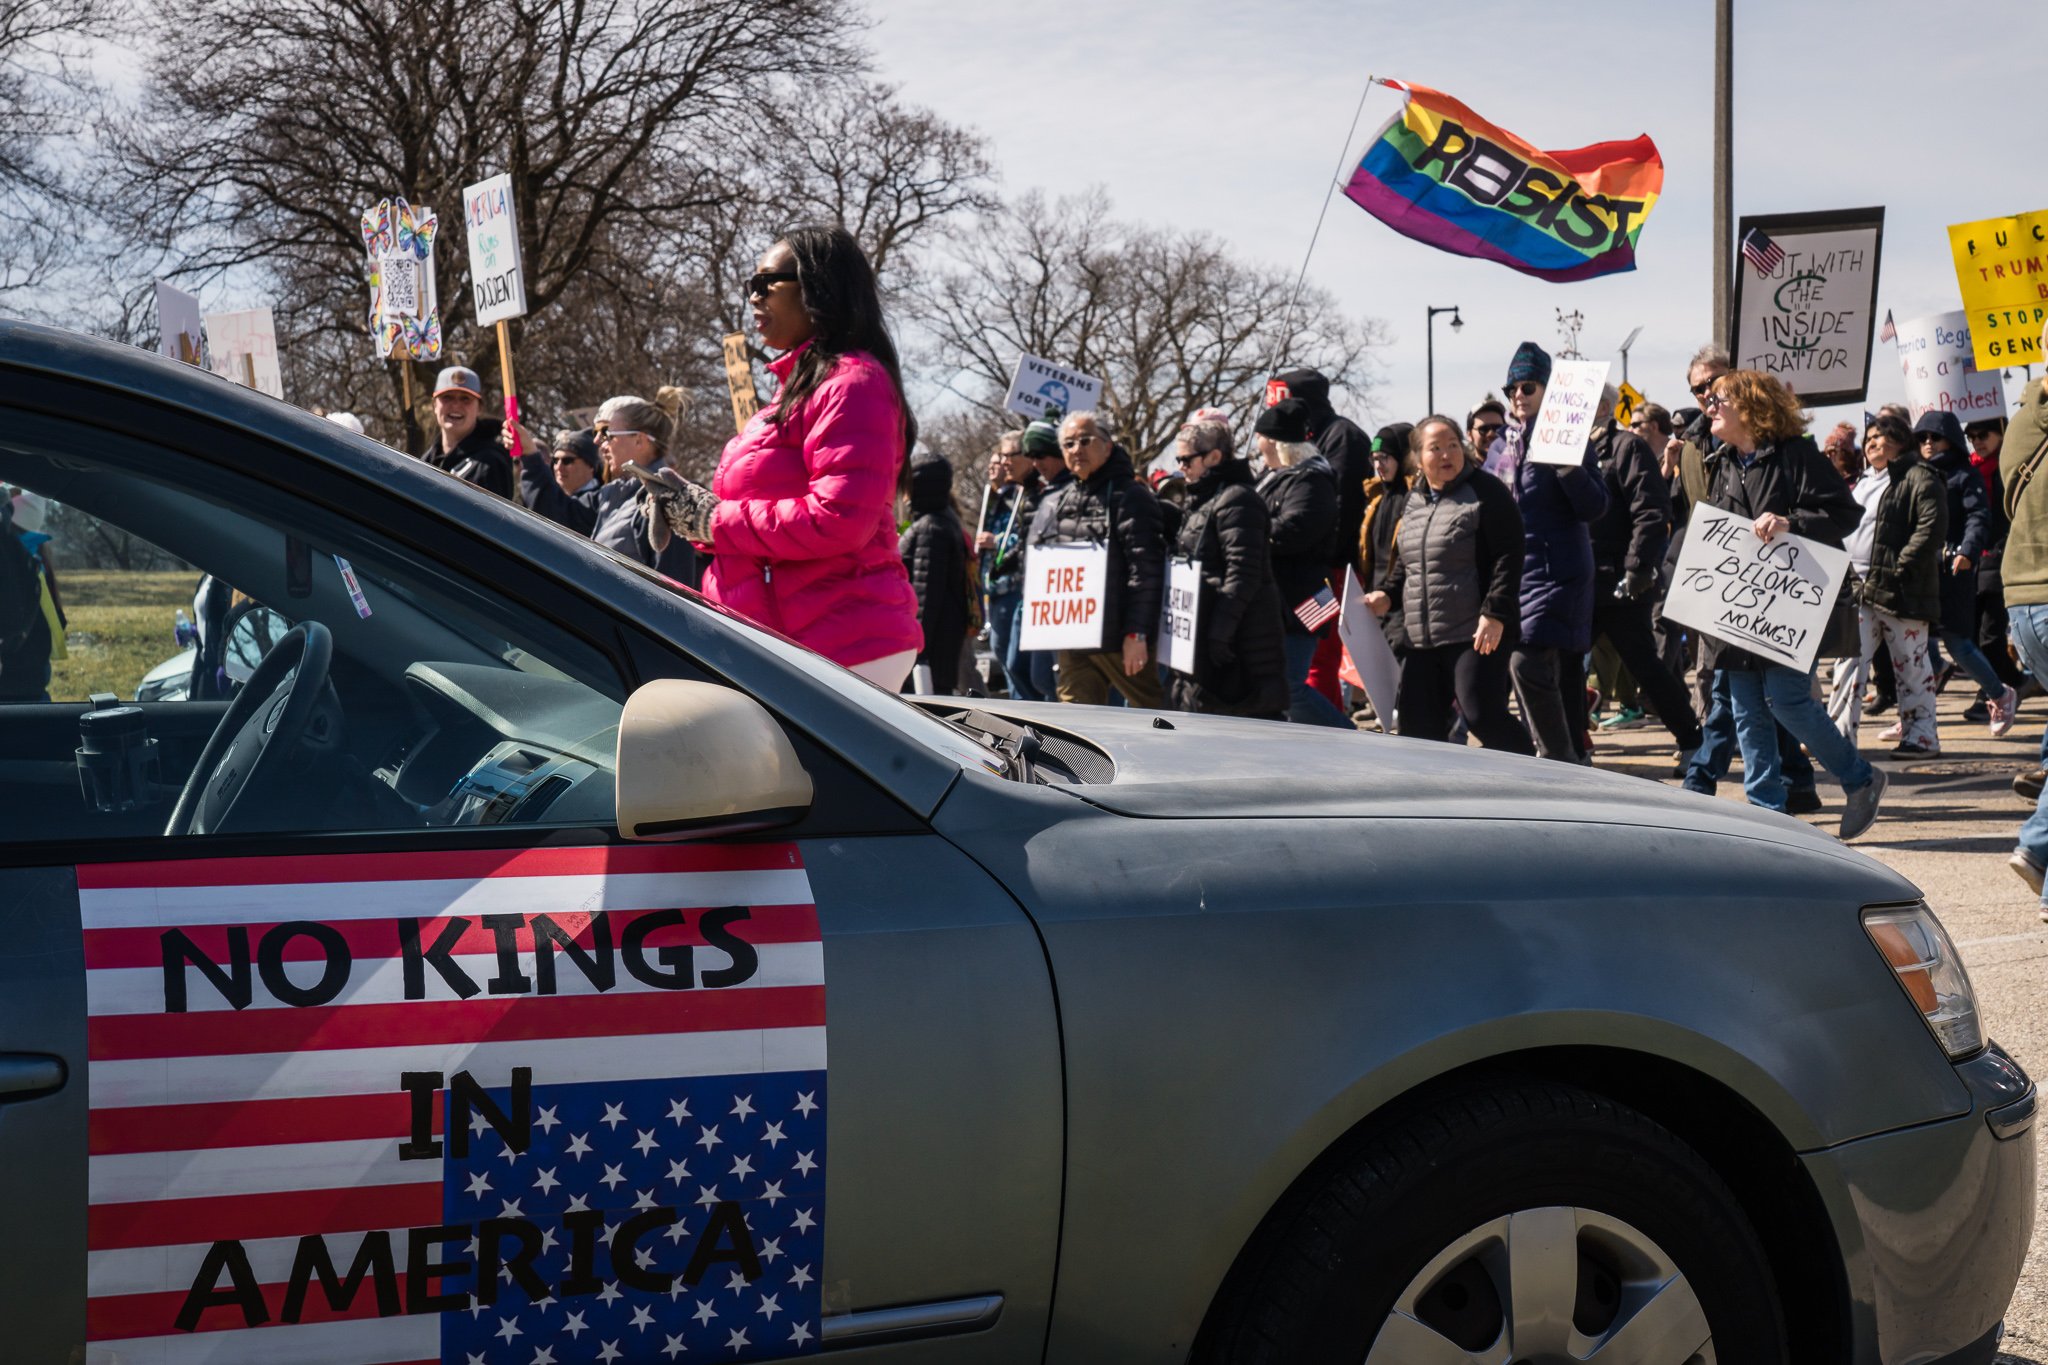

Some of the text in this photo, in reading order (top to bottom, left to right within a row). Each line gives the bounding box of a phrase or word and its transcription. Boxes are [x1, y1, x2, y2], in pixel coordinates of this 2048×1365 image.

[1412, 119, 1646, 251] RESIST
[466, 188, 507, 232] AMERICA
[1757, 250, 1864, 280] UT WITH
[1979, 254, 2048, 282] TRUM
[476, 268, 516, 313] DISSENT
[1788, 283, 1825, 304] THE
[1762, 311, 1855, 342] INSIDE
[1987, 308, 2044, 329] STOP
[1747, 349, 1848, 373] TRAITOR
[1937, 361, 1949, 376] a
[1028, 361, 1093, 392] VETERANS
[1555, 372, 1574, 387] NO
[1017, 392, 1041, 407] FOR
[1940, 386, 2000, 413] Protest
[1544, 409, 1561, 424] NO
[1538, 428, 1554, 444] NO
[1703, 517, 1799, 572] THE U.S.
[1046, 566, 1085, 594] FIRE
[1682, 568, 1777, 615] TO US!
[1715, 556, 1824, 606] BELONGS
[1031, 598, 1096, 626] TRUMP
[1720, 610, 1807, 649] NO KINGS!
[160, 919, 353, 1014] NO
[399, 906, 760, 1001] KINGS
[399, 1066, 533, 1161] IN
[174, 1202, 763, 1333] AMERICA
